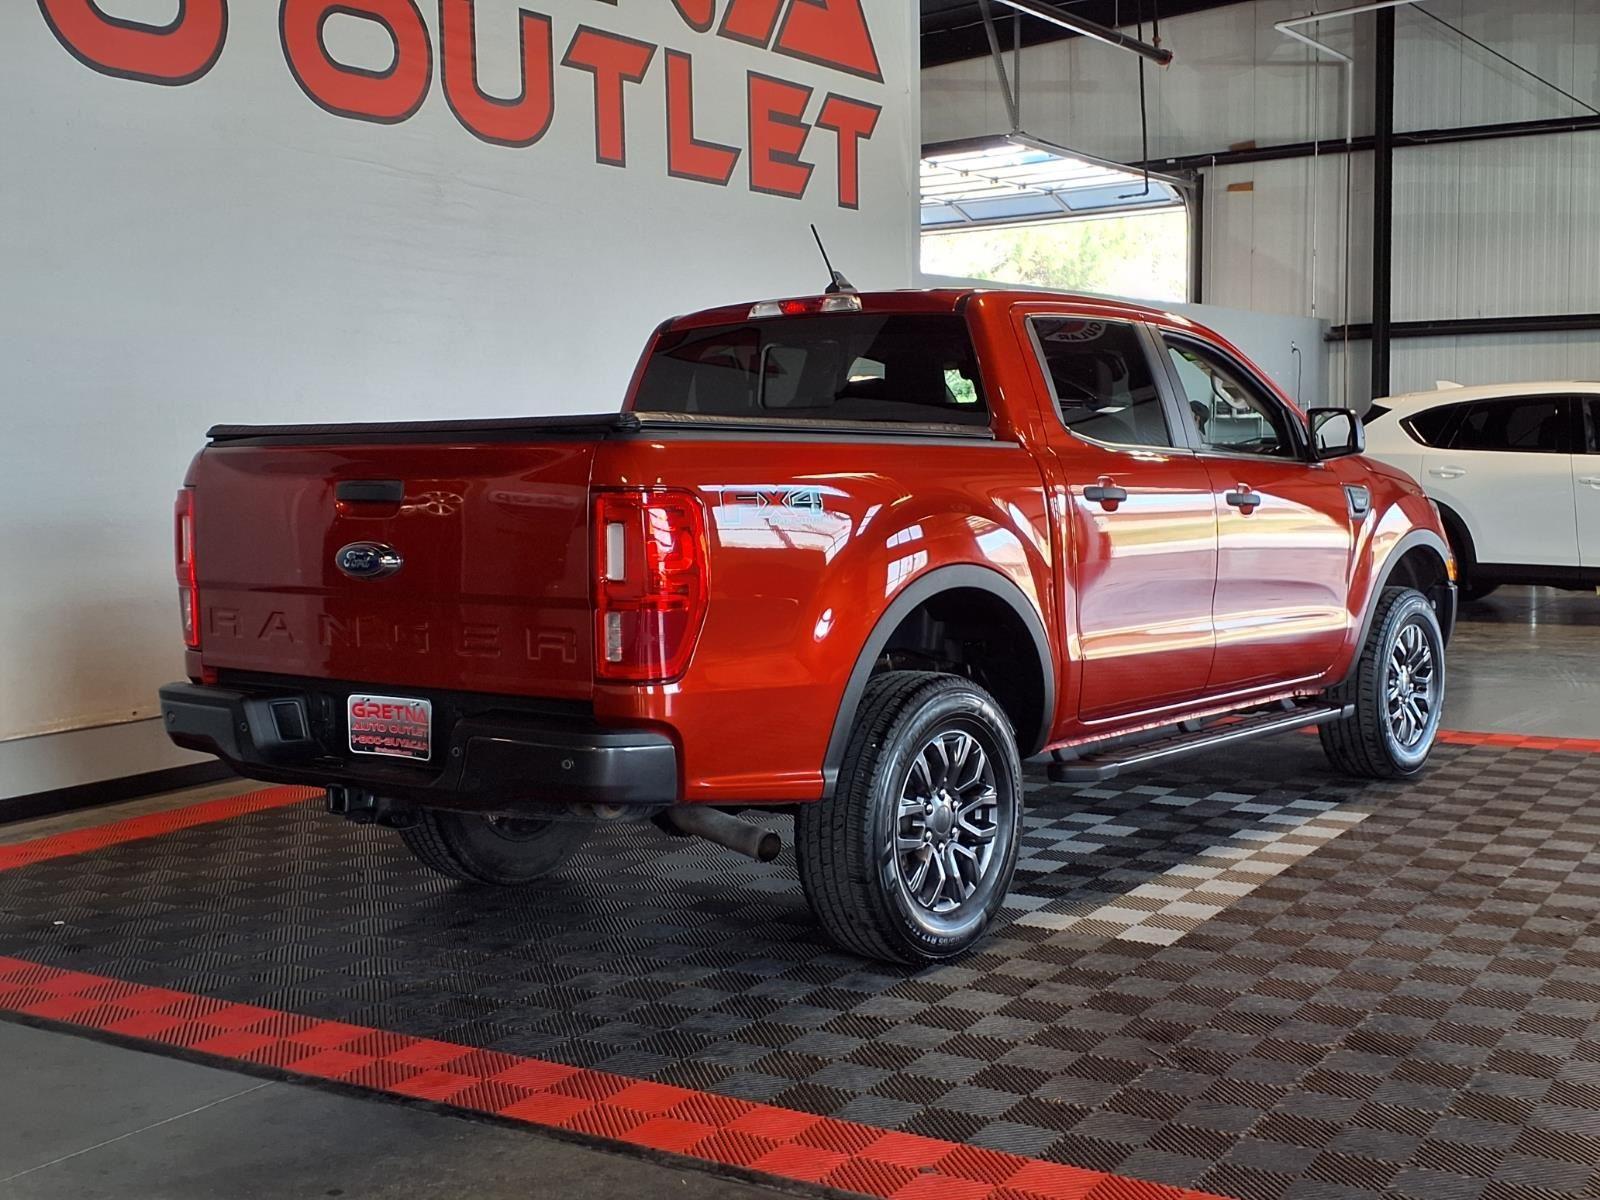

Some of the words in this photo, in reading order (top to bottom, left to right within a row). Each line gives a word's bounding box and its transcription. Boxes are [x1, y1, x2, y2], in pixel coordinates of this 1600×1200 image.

[278, 0, 883, 211] OUTLET
[720, 488, 823, 525] FX4
[208, 606, 578, 664] RANGER
[352, 703, 428, 723] GRETNA
[352, 721, 386, 732] AUTO
[389, 725, 428, 737] OUTLET
